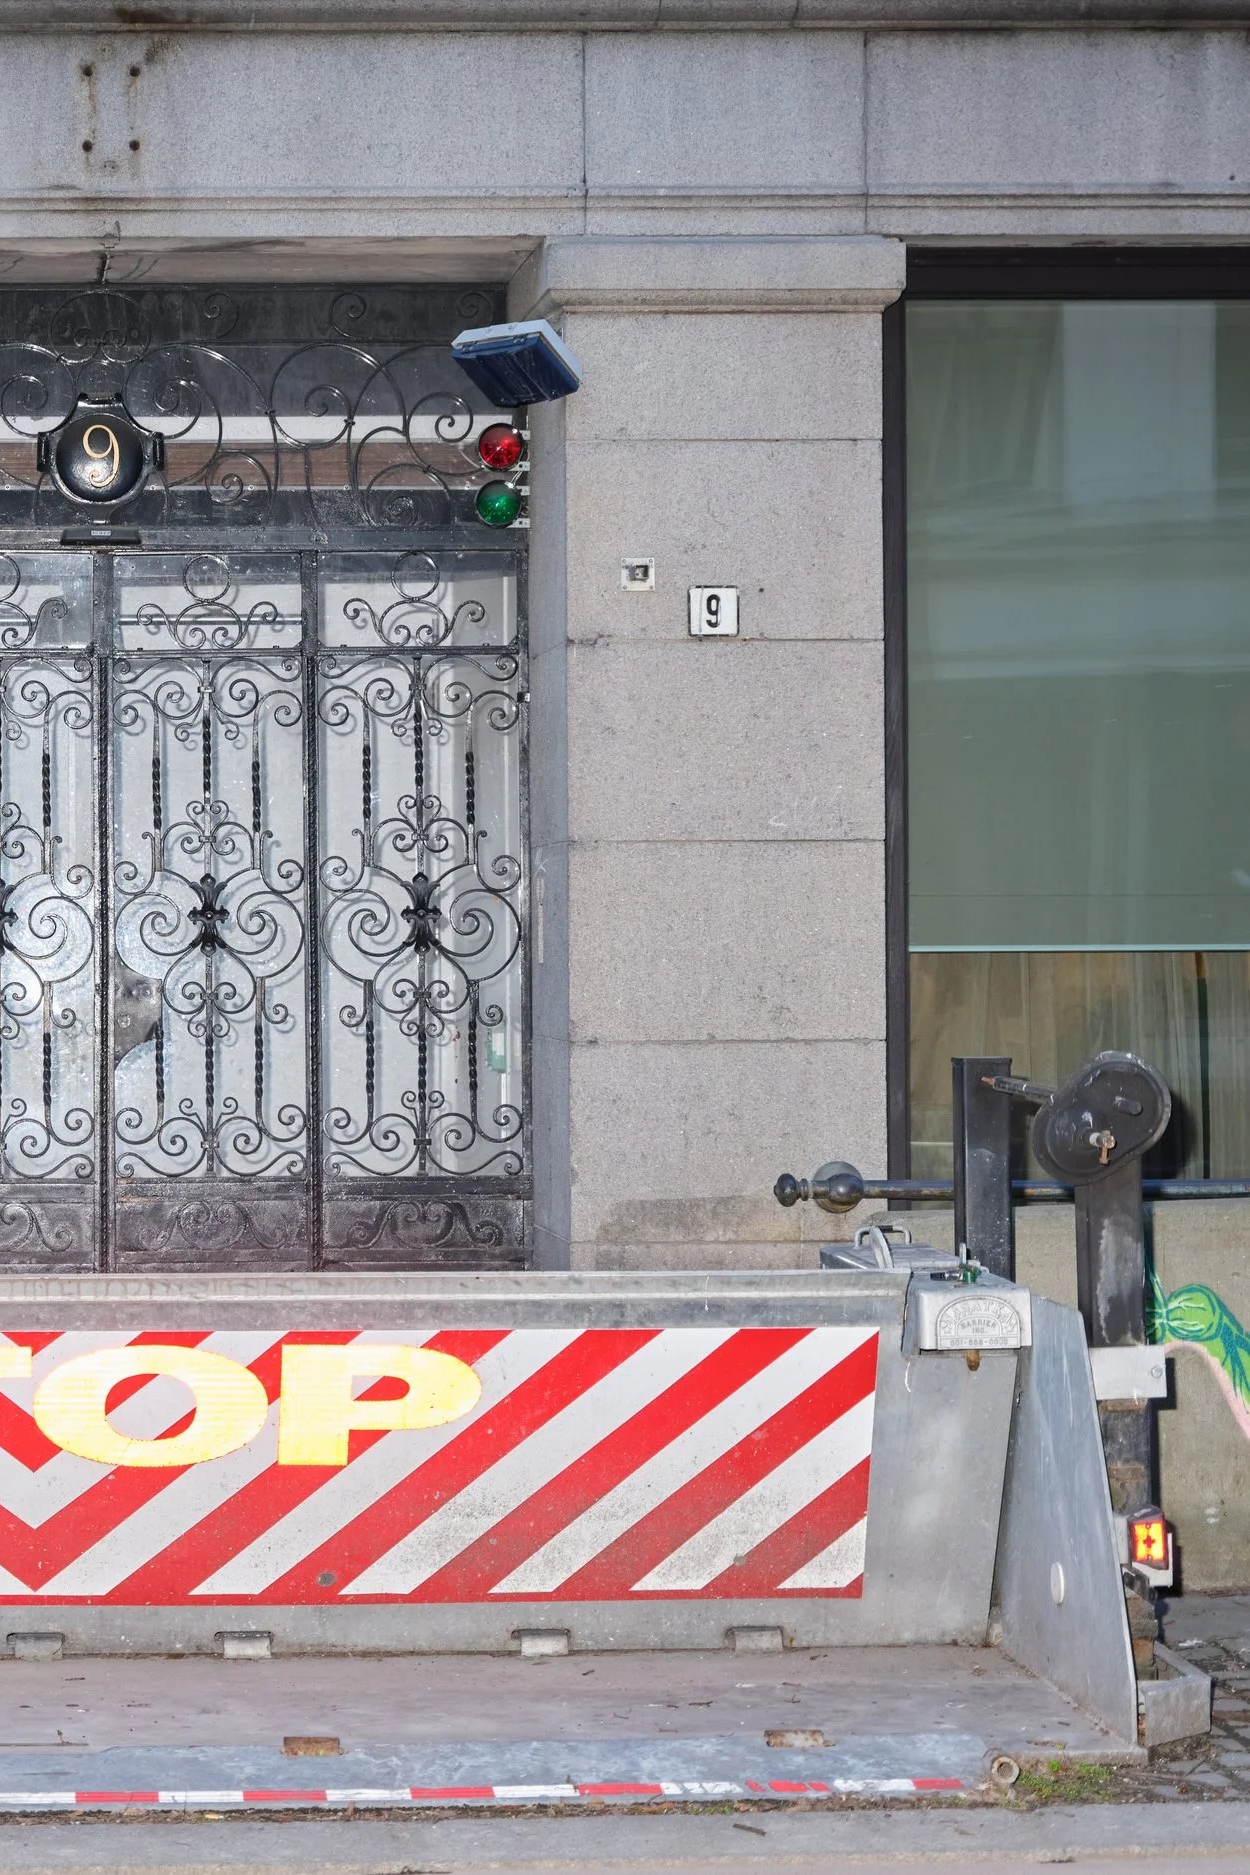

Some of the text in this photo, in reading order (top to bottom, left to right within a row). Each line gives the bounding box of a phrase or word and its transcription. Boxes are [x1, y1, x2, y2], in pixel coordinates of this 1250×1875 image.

[82, 424, 120, 488] 9
[706, 594, 720, 628] 9
[961, 1319, 996, 1329] BARRIER
